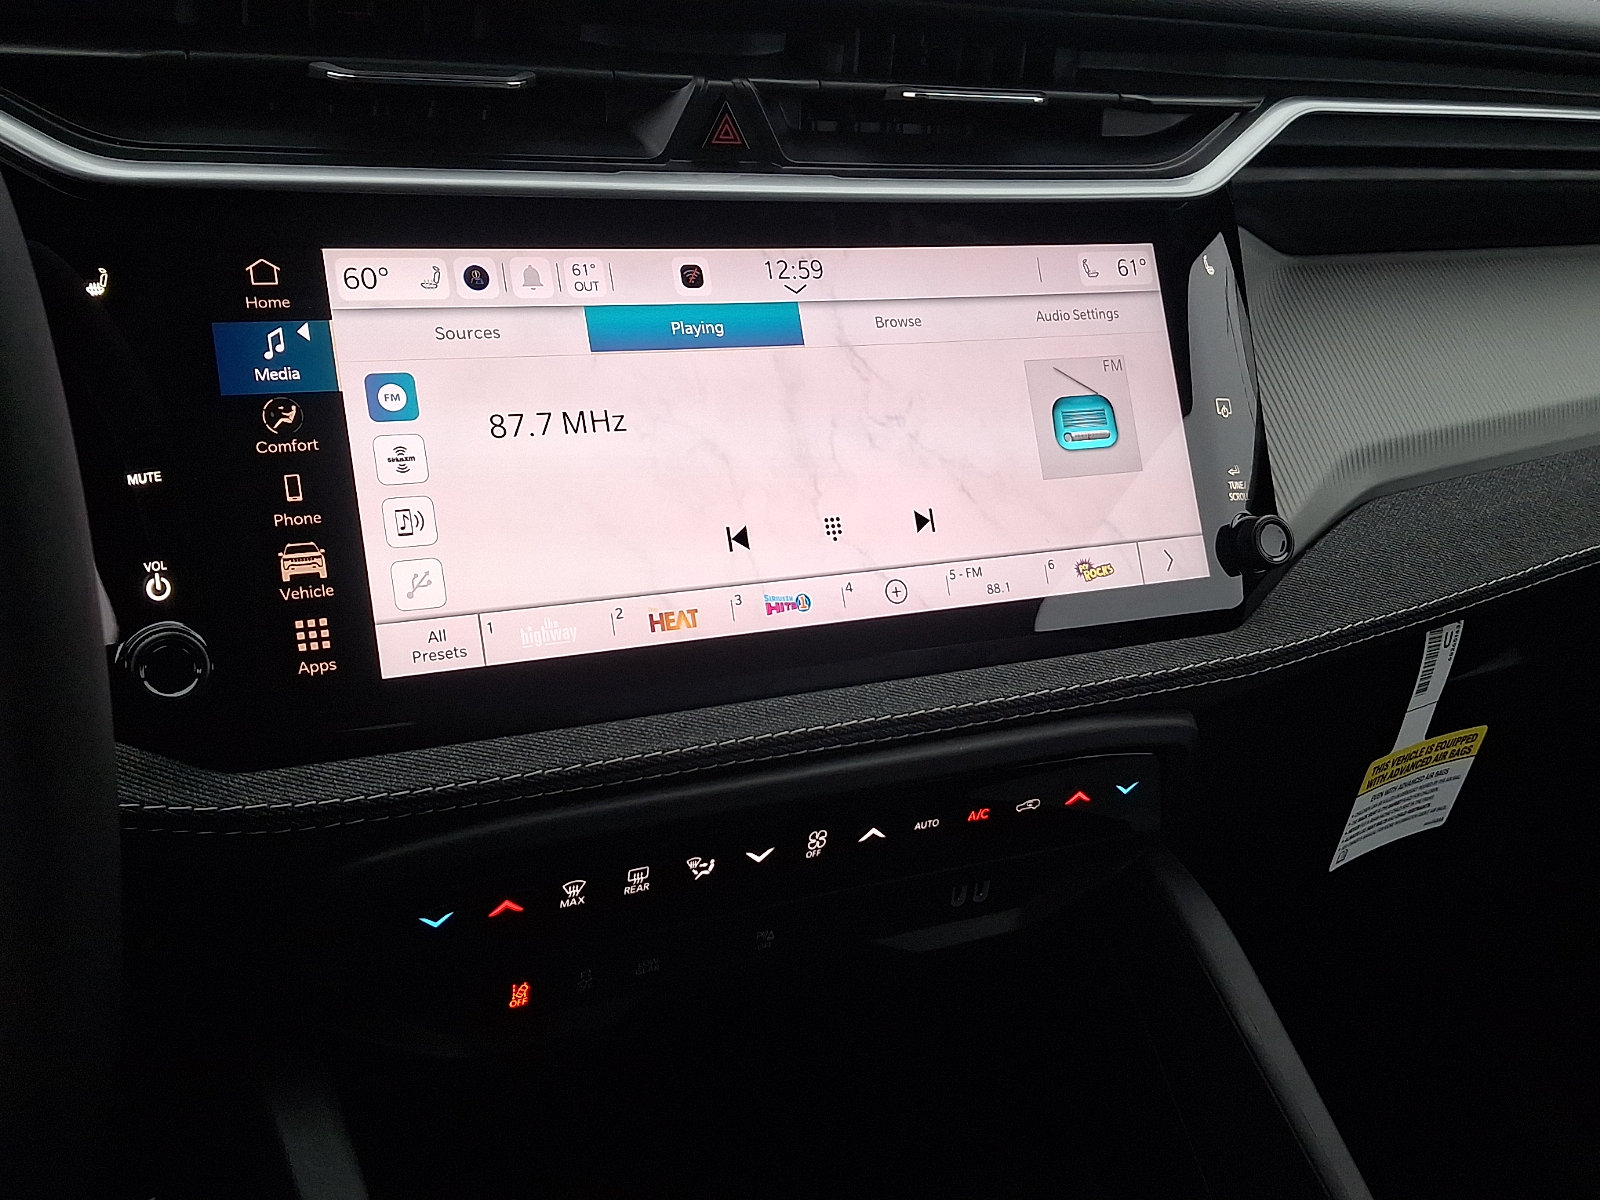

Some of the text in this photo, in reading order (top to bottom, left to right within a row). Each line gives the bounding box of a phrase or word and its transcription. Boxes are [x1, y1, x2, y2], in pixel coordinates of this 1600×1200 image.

[572, 263, 596, 277] 61°
[764, 258, 823, 281] 12:59
[1117, 257, 1147, 278] 61°
[343, 266, 389, 290] 60°
[574, 280, 600, 293] OUT
[245, 296, 291, 310] Home
[874, 313, 922, 330] Browse
[1035, 306, 1120, 326] Audio Settings
[434, 325, 501, 341] Sources
[671, 320, 725, 338] Playing
[1102, 358, 1124, 373] FM
[254, 366, 301, 382] Media
[383, 392, 401, 403] FM
[488, 409, 628, 439] 87.7 MHz
[255, 437, 320, 454] Comfort
[126, 470, 163, 486] MUTE
[273, 512, 322, 527] Phone
[143, 560, 168, 573] VOL
[949, 568, 957, 580] 5
[965, 565, 983, 578] FM
[1047, 559, 1056, 570] 6
[1083, 563, 1115, 582] ROCKS
[279, 583, 335, 601] Vehicle
[845, 582, 853, 594] 4
[987, 580, 1011, 596] 88.1
[734, 594, 743, 607] 3
[614, 607, 625, 620] 2
[765, 602, 797, 616] HITS
[486, 622, 494, 635] 1
[648, 608, 698, 633] HEAT
[427, 628, 447, 644] All
[520, 623, 577, 648] highway
[411, 646, 468, 664] Presets
[298, 660, 338, 677] Apps
[1371, 733, 1479, 777] THIS VEHICLE IS EQUIPPED
[1366, 744, 1474, 790] WITH ADVANCED AIR BAGS
[967, 808, 990, 822] A/C
[914, 818, 940, 831] AUTO
[805, 849, 822, 859] OFF
[623, 881, 650, 896] REAR
[559, 895, 586, 909] MAX
[509, 997, 528, 1009] OFF
